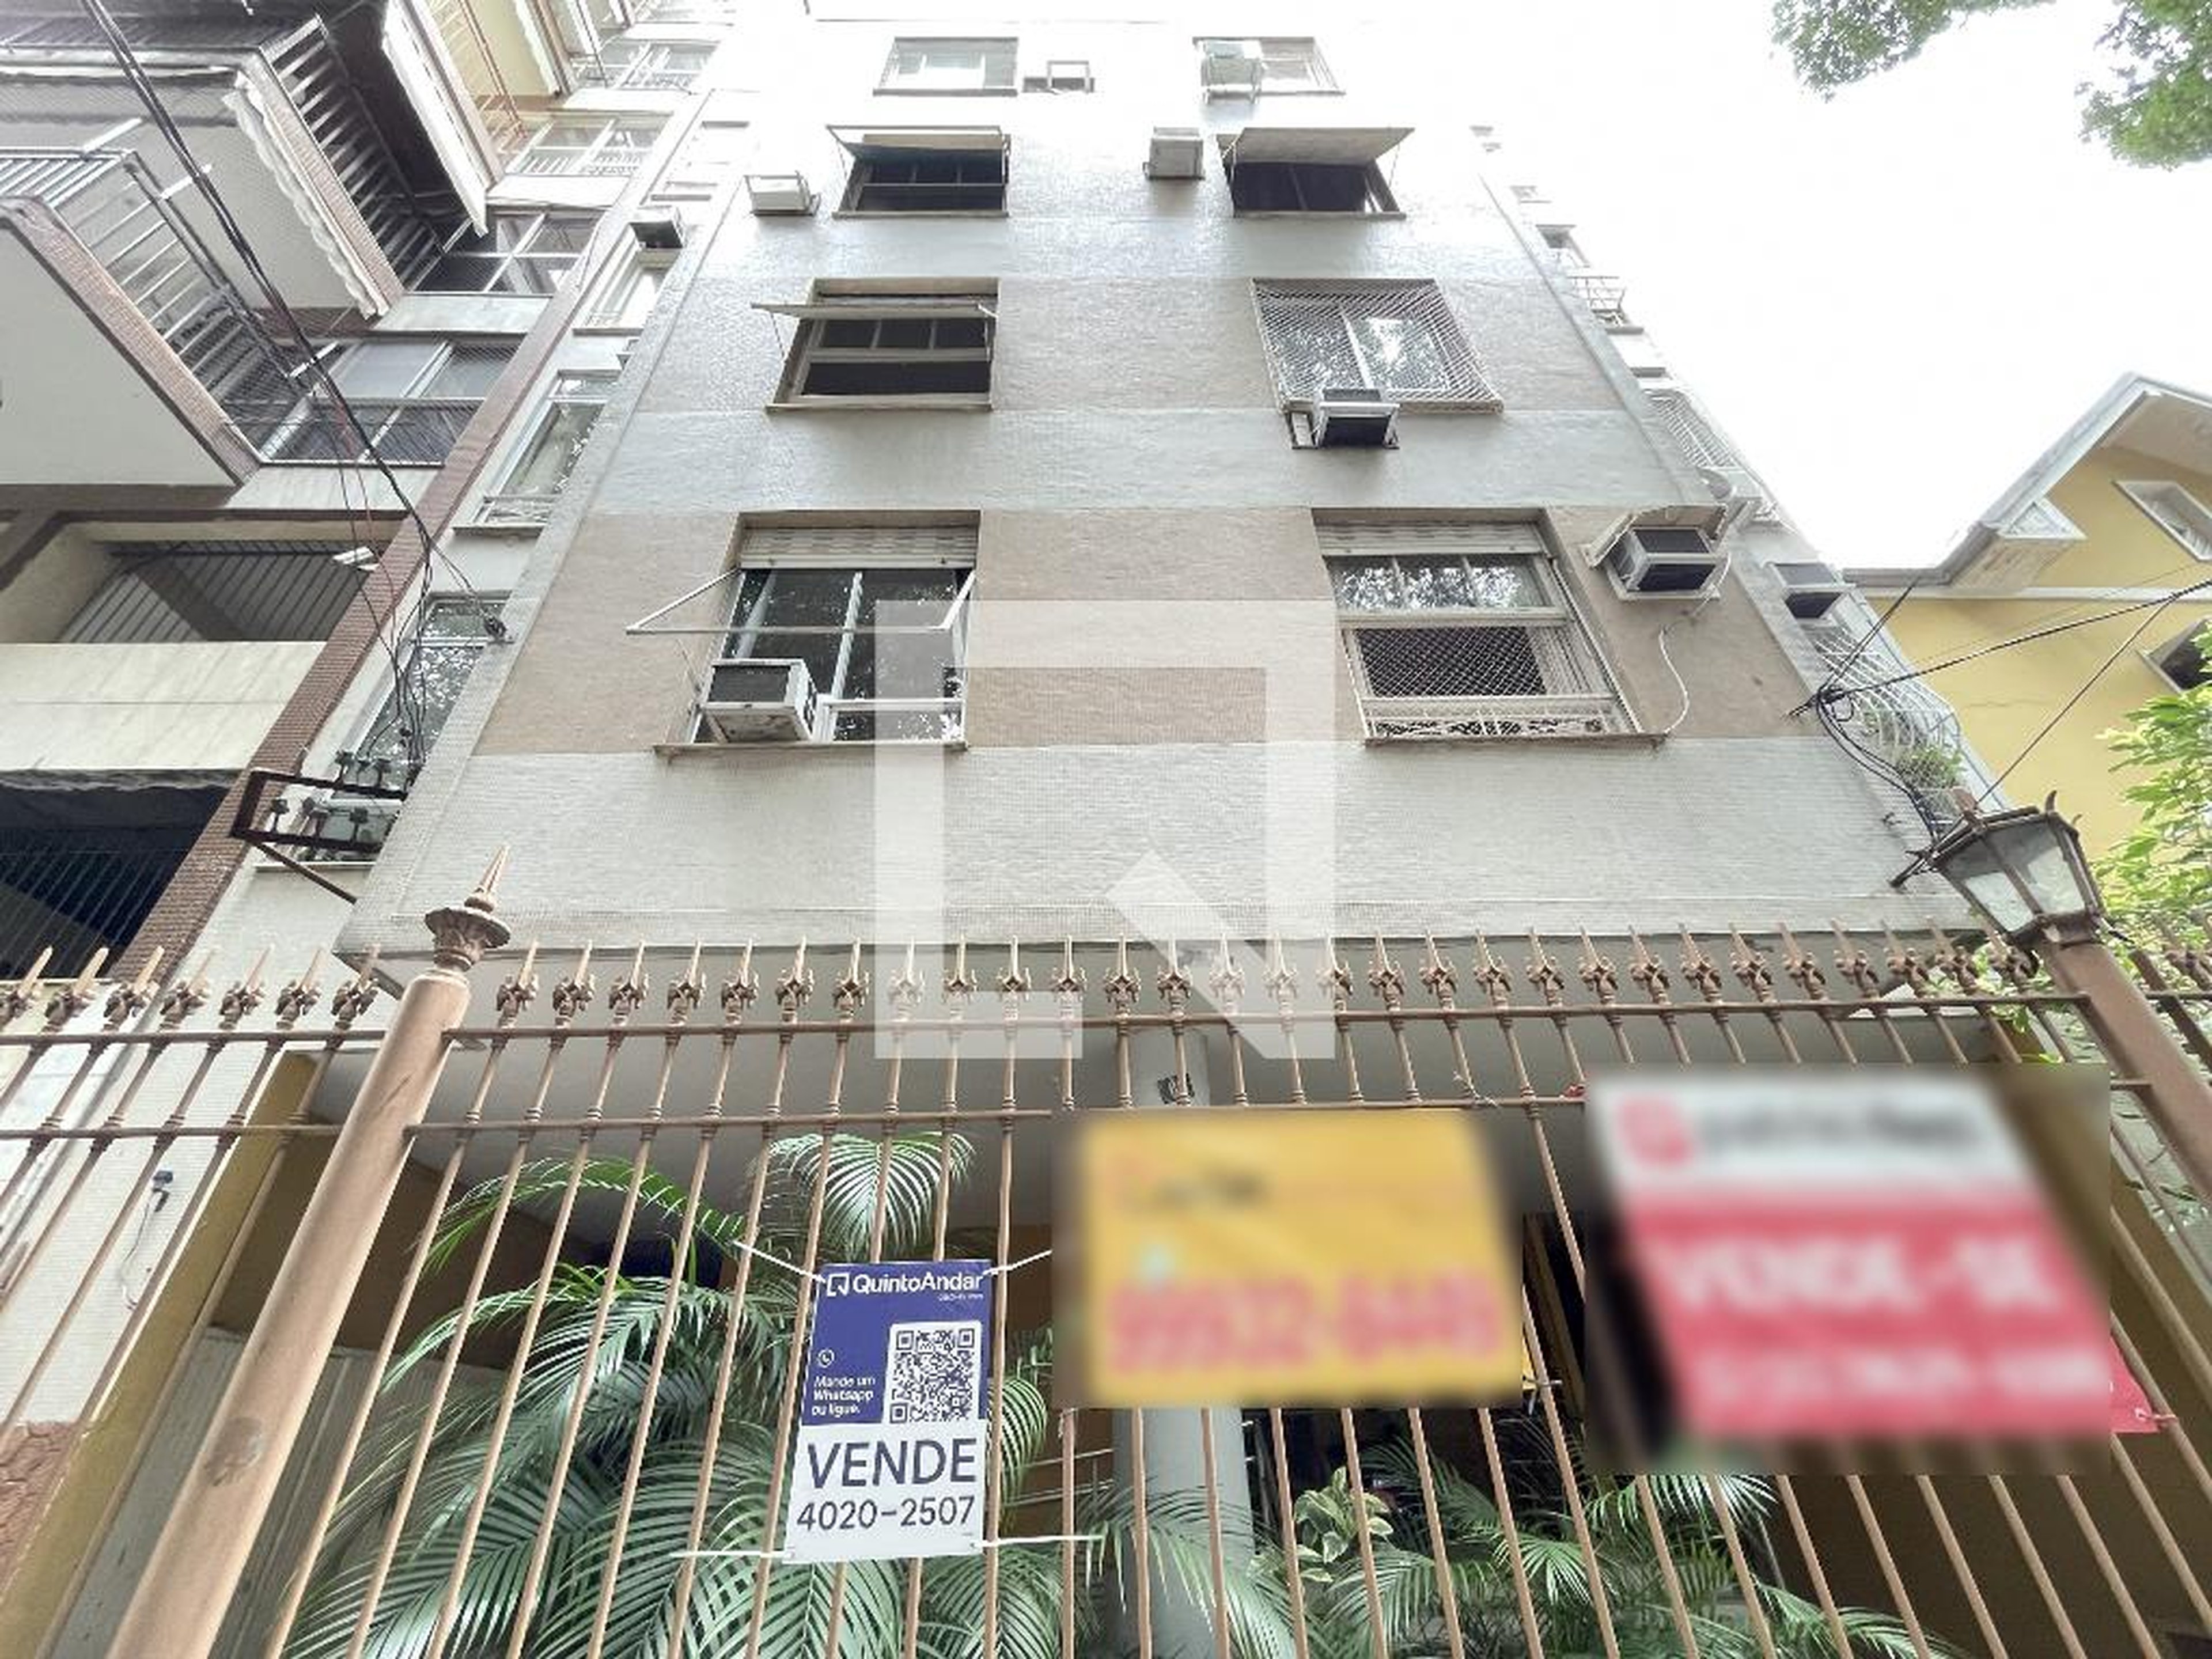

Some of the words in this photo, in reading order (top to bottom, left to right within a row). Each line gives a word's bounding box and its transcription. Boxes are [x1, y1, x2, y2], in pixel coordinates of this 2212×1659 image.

[853, 1271, 983, 1294] QuintoAndar
[814, 1376, 855, 1388] Mande
[808, 1438, 977, 1489] VENDE
[797, 1496, 975, 1532] 4020-2507
